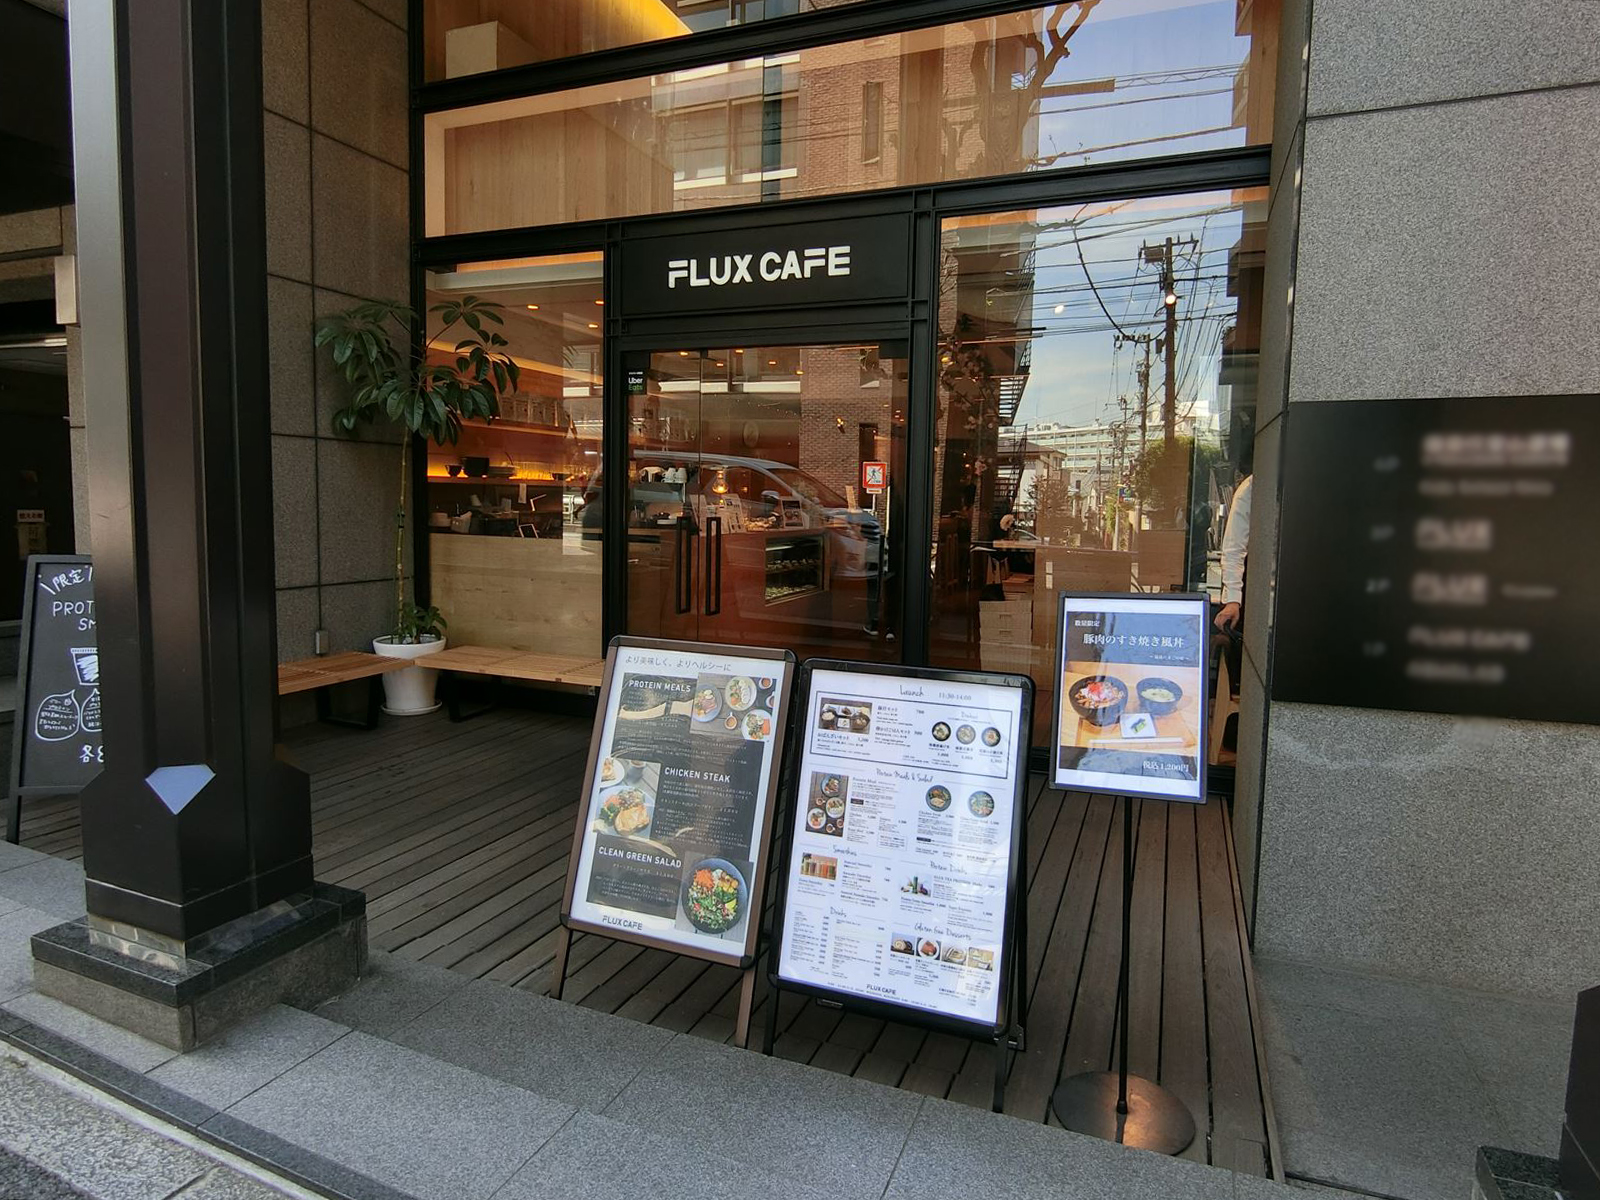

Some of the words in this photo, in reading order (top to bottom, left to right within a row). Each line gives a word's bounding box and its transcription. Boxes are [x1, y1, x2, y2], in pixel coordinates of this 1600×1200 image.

[668, 254, 753, 289] FLUX
[759, 245, 851, 281] CAFE
[1083, 633, 1184, 648] 豚肉のすき焼き風丼
[628, 680, 662, 690] PROTEIN
[664, 683, 691, 693] MEALS
[664, 767, 701, 779] CHICKEN
[703, 772, 731, 783] STEAK
[598, 846, 624, 859] CLEAN
[626, 851, 653, 864] GREEN
[654, 856, 682, 868] SALAD
[602, 915, 622, 926] FLUX
[622, 919, 643, 930] CAFE
